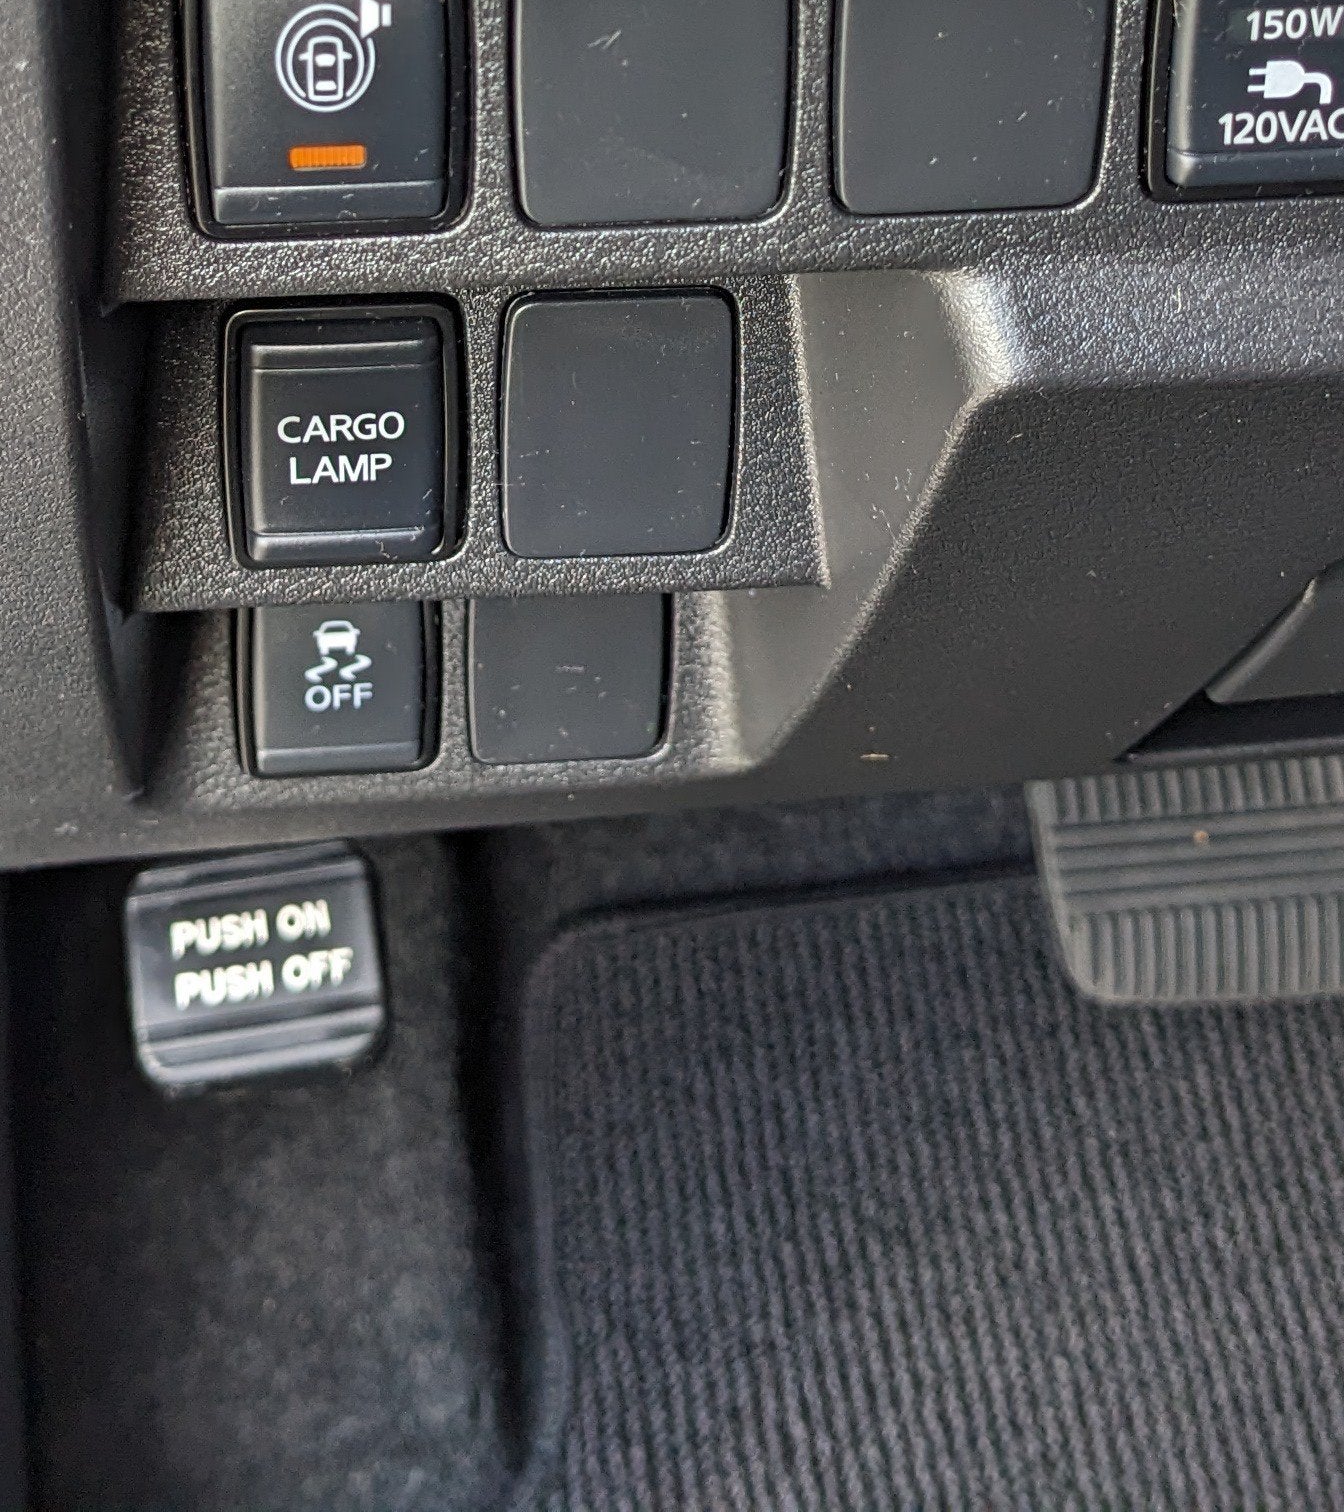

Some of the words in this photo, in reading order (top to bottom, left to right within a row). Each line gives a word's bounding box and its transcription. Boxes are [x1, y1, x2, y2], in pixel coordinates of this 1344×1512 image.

[1246, 5, 1344, 41] 150W
[277, 411, 405, 444] CARGO
[289, 453, 393, 485] LAMP
[304, 682, 373, 713] OFF
[170, 908, 269, 961] PUSH
[276, 898, 332, 942] ON
[174, 959, 275, 1010] PUSH
[281, 946, 354, 992] OFF
